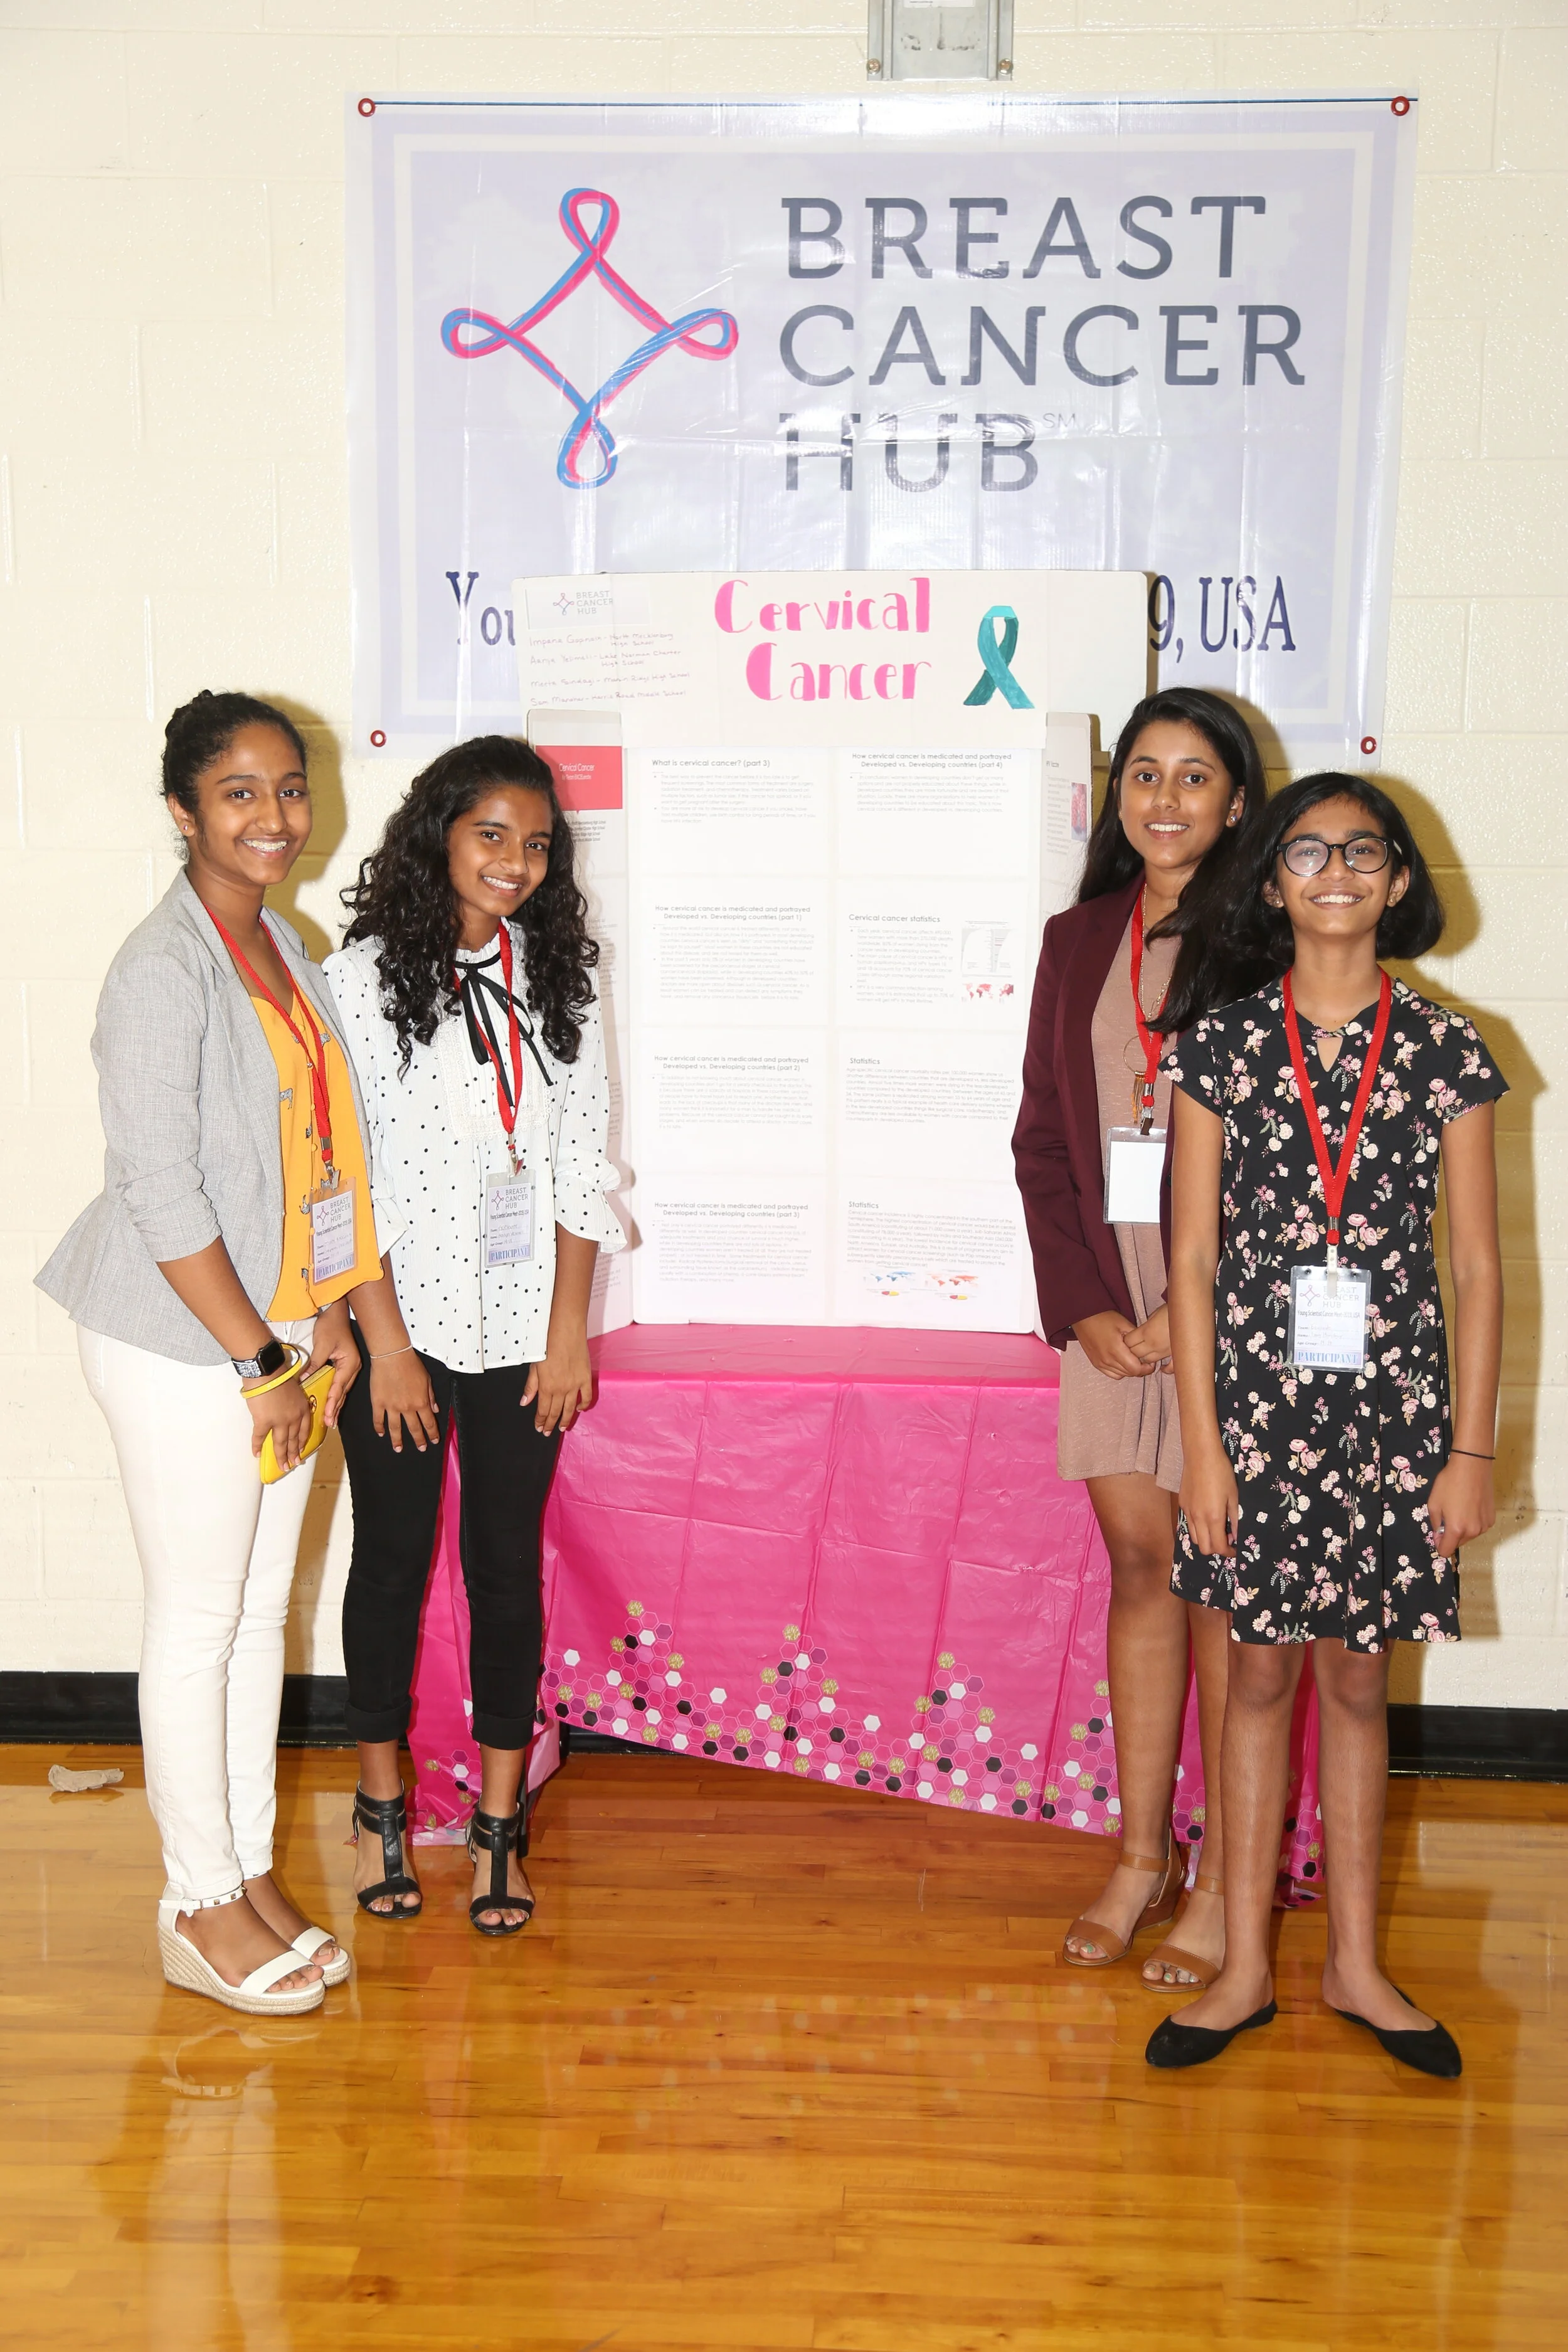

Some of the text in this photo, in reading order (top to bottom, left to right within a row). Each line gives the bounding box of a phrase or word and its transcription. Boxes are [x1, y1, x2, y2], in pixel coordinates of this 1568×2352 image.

[781, 196, 1266, 280] BREAST
[779, 304, 1305, 386] CANCER
[779, 412, 1076, 491] HUB SM
[576, 590, 610, 599] BREAST
[576, 598, 613, 607] CANCER
[714, 577, 930, 633] Cervical
[1199, 575, 1296, 652] USA
[746, 642, 931, 701] Cancer
[978, 753, 1012, 761] portrayed
[763, 760, 770, 768] 3)
[710, 913, 747, 921] Developing
[747, 1064, 776, 1072] countries
[506, 1187, 526, 1195] BREAST
[331, 1197, 349, 1209] BREAST
[506, 1194, 528, 1202] CANCER
[331, 1204, 351, 1216] CANCER
[849, 1201, 879, 1209] Statistics
[331, 1214, 341, 1223] HUB
[709, 1210, 746, 1218] Developing
[491, 1247, 528, 1261] PARTICIPANT
[319, 1256, 352, 1278] PARTICIPANT
[1298, 1352, 1358, 1364] PARTICIPANT
